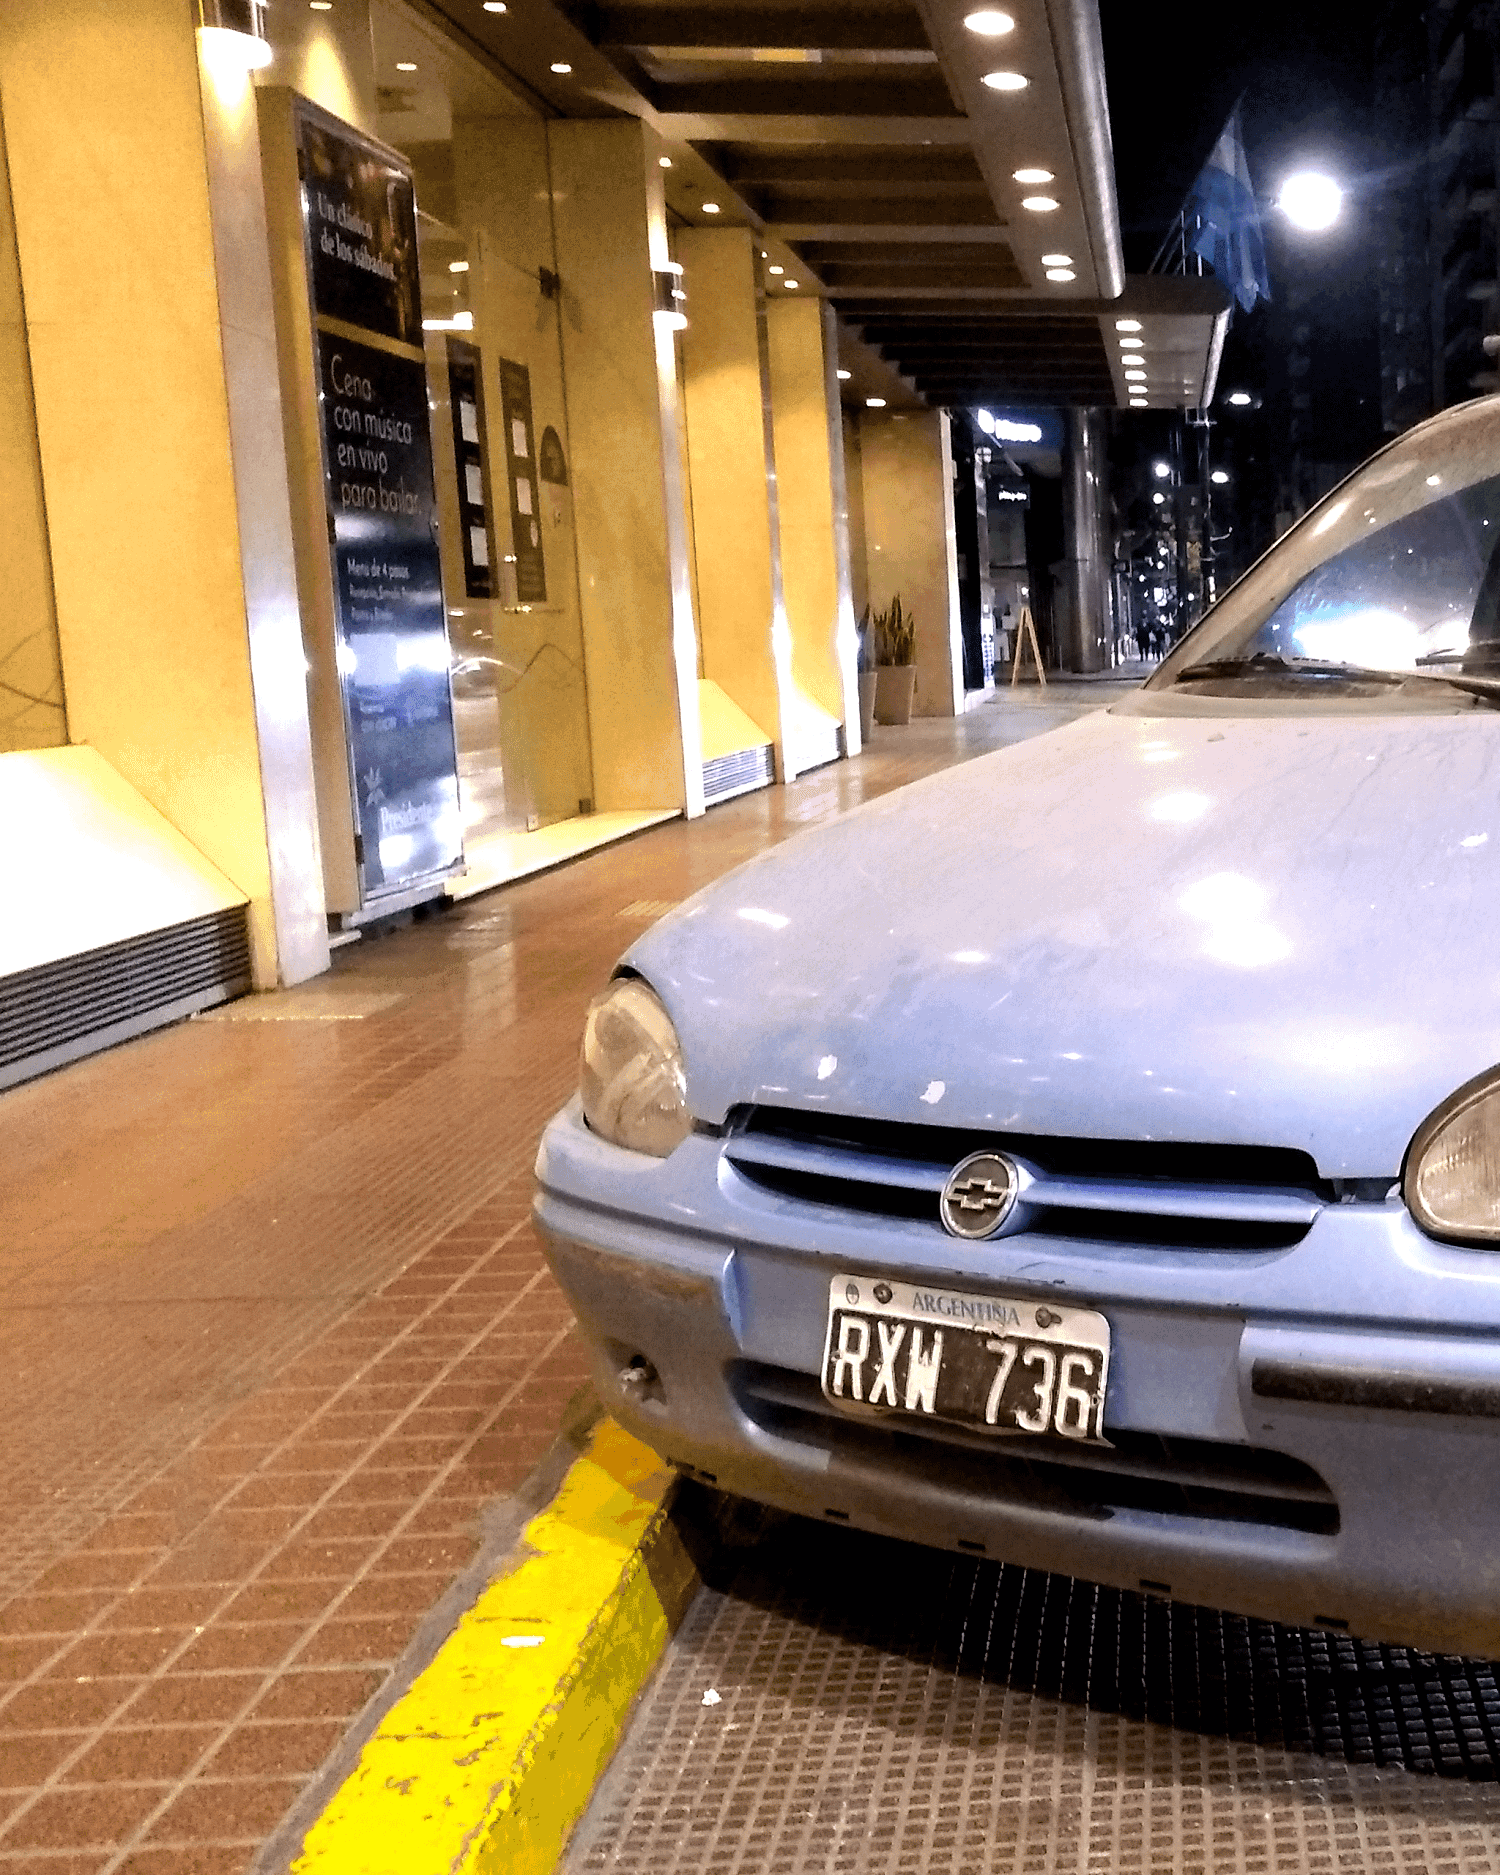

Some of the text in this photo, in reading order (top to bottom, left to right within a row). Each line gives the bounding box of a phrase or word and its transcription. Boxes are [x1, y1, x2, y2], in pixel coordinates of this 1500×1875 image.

[318, 191, 335, 223] Un
[320, 226, 336, 256] de
[336, 232, 353, 263] los
[330, 353, 372, 402] Cena
[333, 404, 413, 445] con música
[337, 440, 389, 474] en vivo
[341, 481, 376, 514] para
[912, 1291, 1021, 1327] ARGENTINA
[832, 1313, 1096, 1439] RXW 736
